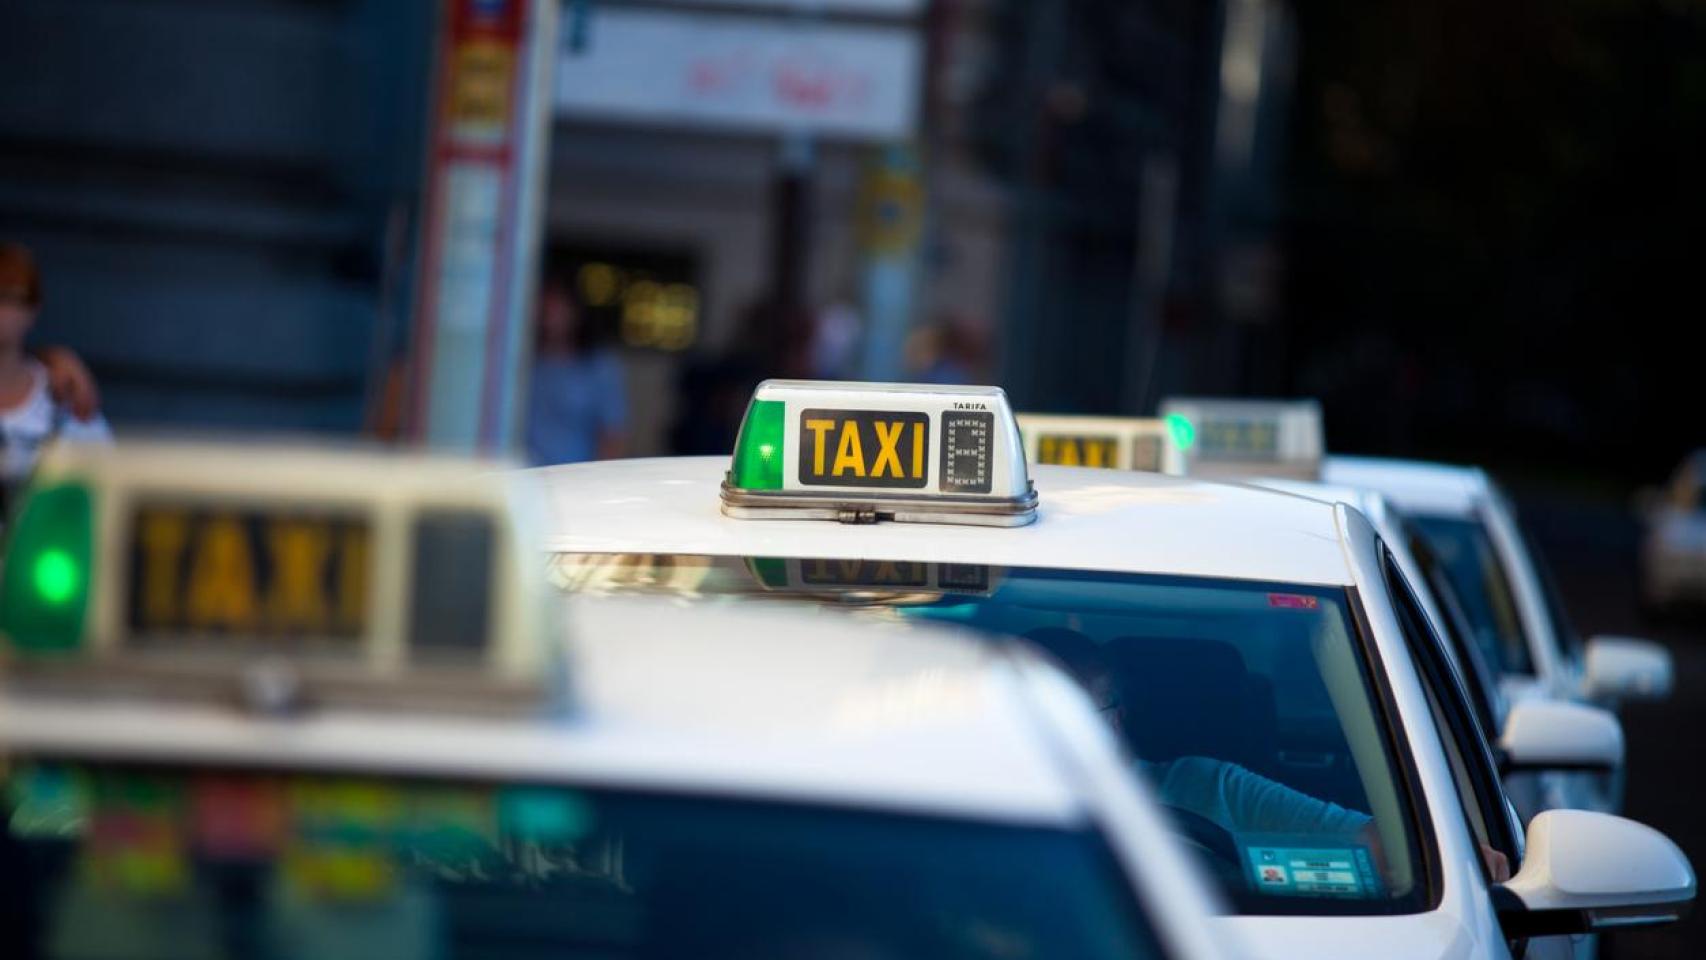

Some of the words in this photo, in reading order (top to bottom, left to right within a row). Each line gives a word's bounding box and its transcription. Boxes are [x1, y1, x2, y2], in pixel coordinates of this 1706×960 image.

[953, 402, 987, 410] TARIFA
[805, 419, 925, 479] TAXI
[138, 508, 369, 630] TAXI
